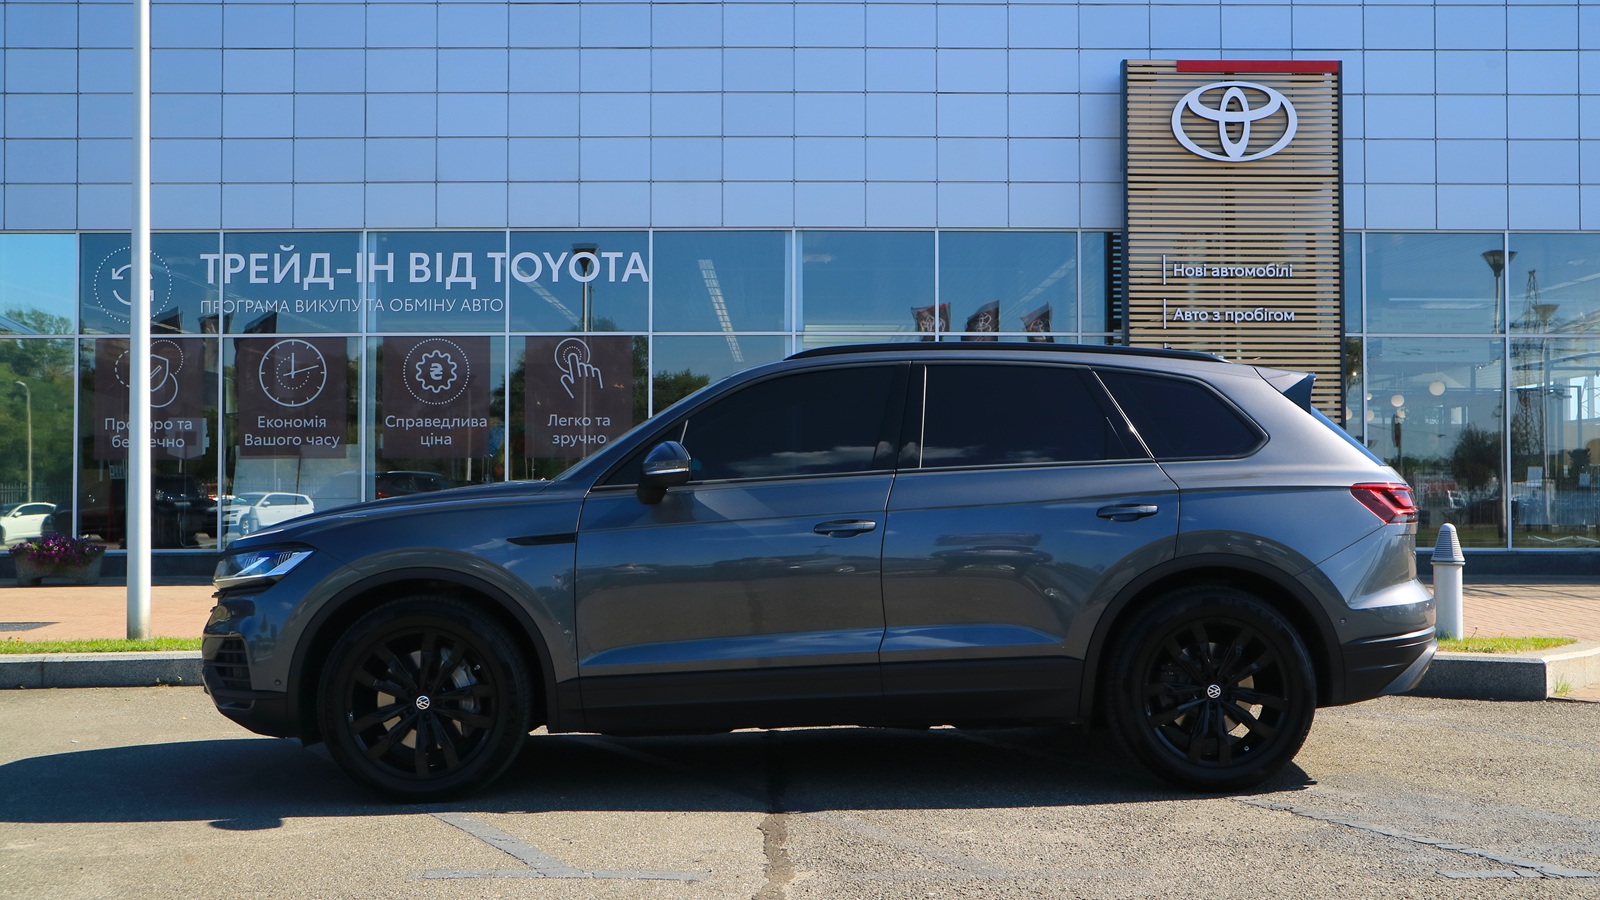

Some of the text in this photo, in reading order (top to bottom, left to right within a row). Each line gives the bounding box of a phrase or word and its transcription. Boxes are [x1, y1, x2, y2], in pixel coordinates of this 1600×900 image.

[199, 245, 649, 290] ТРЕЙД-ІН ВІД TOYOTA
[1173, 263, 1293, 277] Нові автомобілі
[200, 299, 290, 313] ПРОГРАМА
[295, 298, 363, 313] ВИКУПУ
[389, 298, 454, 312] ОБМІНУ
[460, 298, 504, 312] АВТО
[1173, 307, 1295, 324] Авто з пробігом
[177, 420, 193, 430] та
[257, 415, 327, 429] Економія
[385, 415, 488, 430] Справедлива
[547, 414, 611, 427] Легко та
[244, 434, 340, 449] Вашого часу
[420, 433, 452, 446] ціна
[552, 435, 607, 447] зручно
